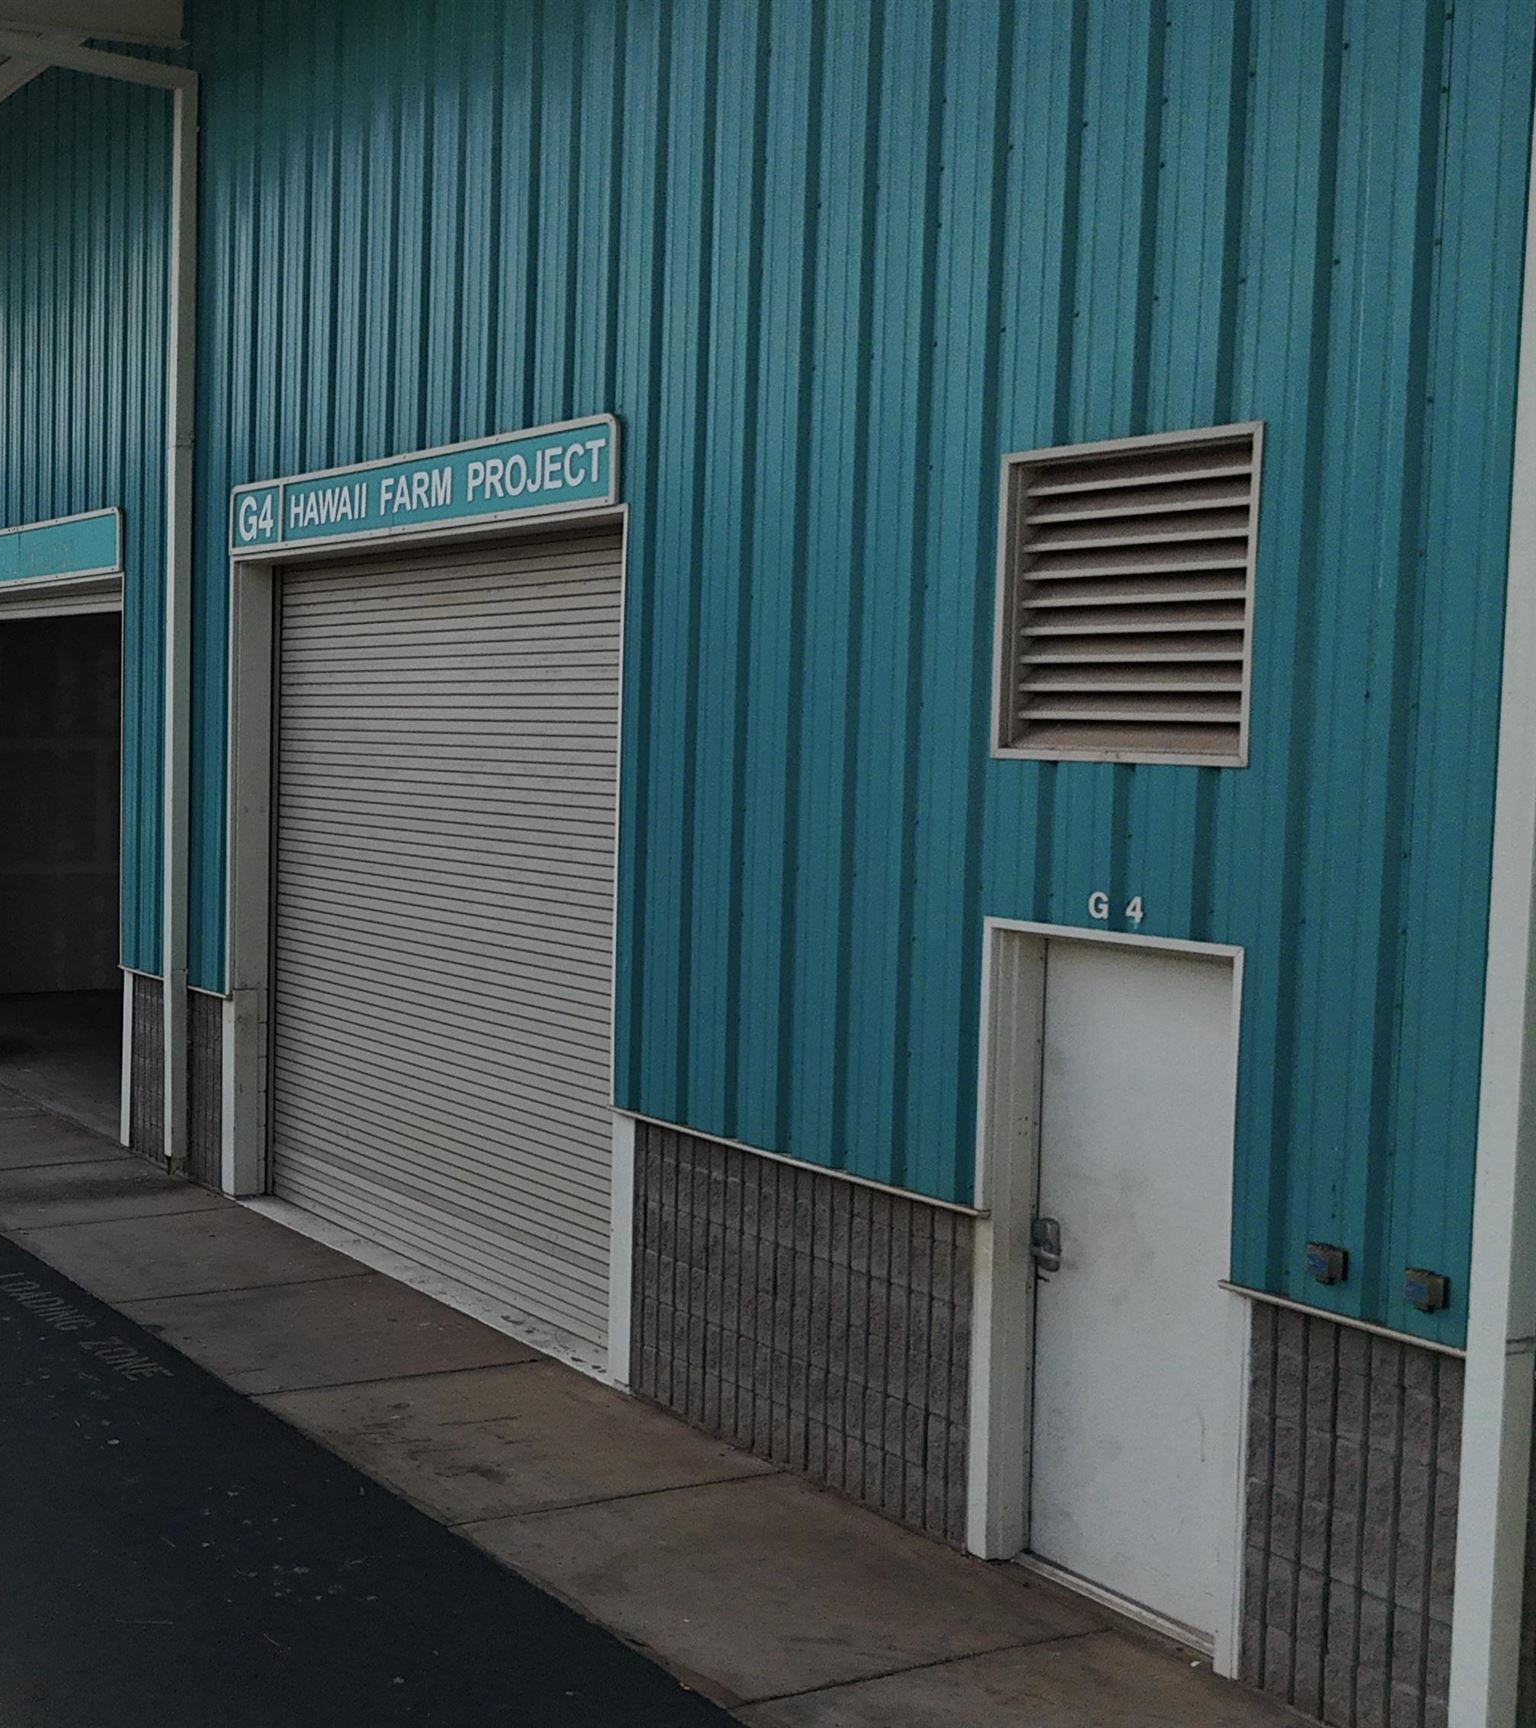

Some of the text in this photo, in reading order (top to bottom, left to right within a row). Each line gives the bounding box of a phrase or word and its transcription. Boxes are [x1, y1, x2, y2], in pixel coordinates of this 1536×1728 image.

[238, 438, 607, 542] G4 HAWAII FARM PROJECT
[79, 1337, 174, 1381] ZONE
